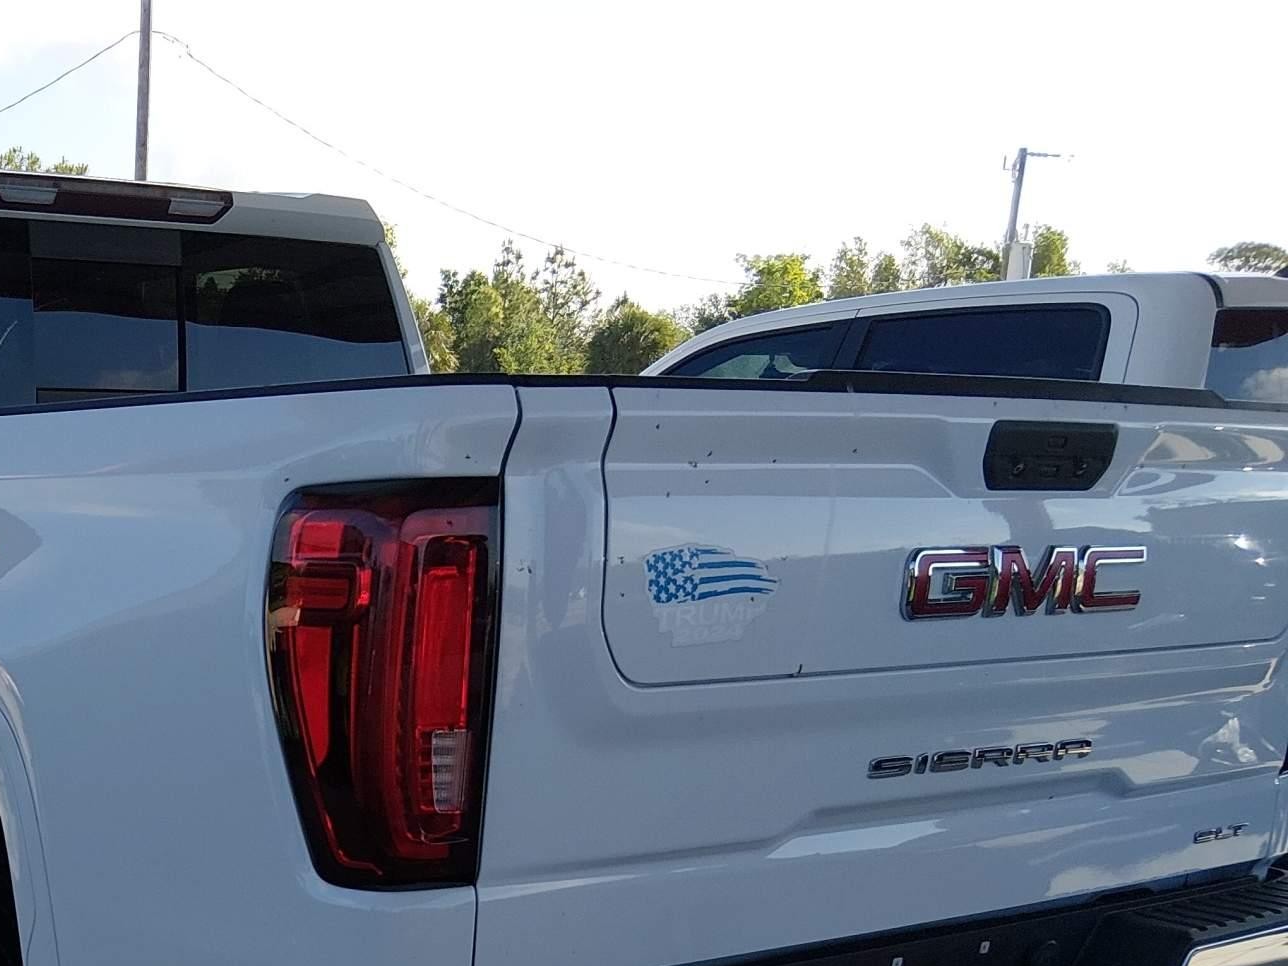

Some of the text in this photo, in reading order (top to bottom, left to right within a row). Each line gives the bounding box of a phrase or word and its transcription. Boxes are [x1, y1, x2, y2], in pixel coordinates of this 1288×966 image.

[901, 545, 1148, 621] GMC
[867, 738, 1094, 779] SIERRA
[1193, 822, 1250, 845] SLT
